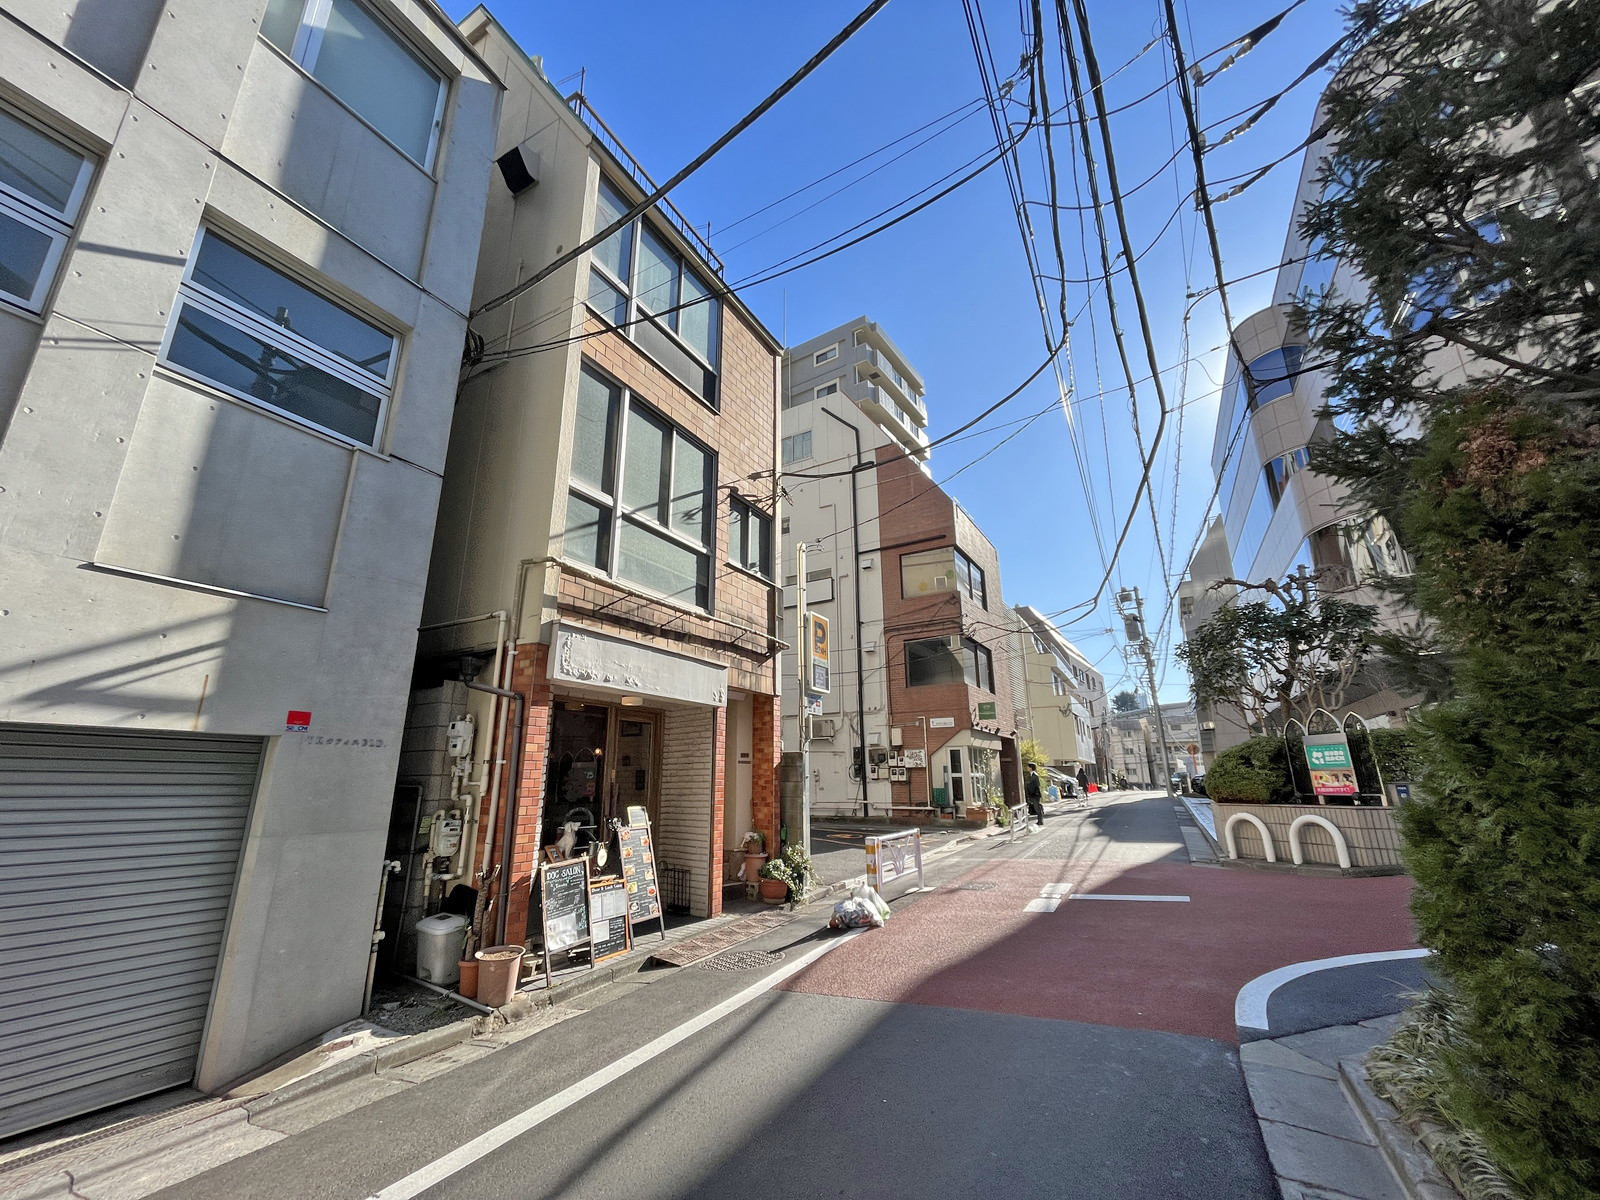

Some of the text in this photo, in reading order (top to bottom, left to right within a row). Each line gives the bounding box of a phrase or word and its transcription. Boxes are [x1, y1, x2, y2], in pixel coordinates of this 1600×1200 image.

[815, 621, 826, 646] P
[546, 866, 581, 880] DOG SALON
